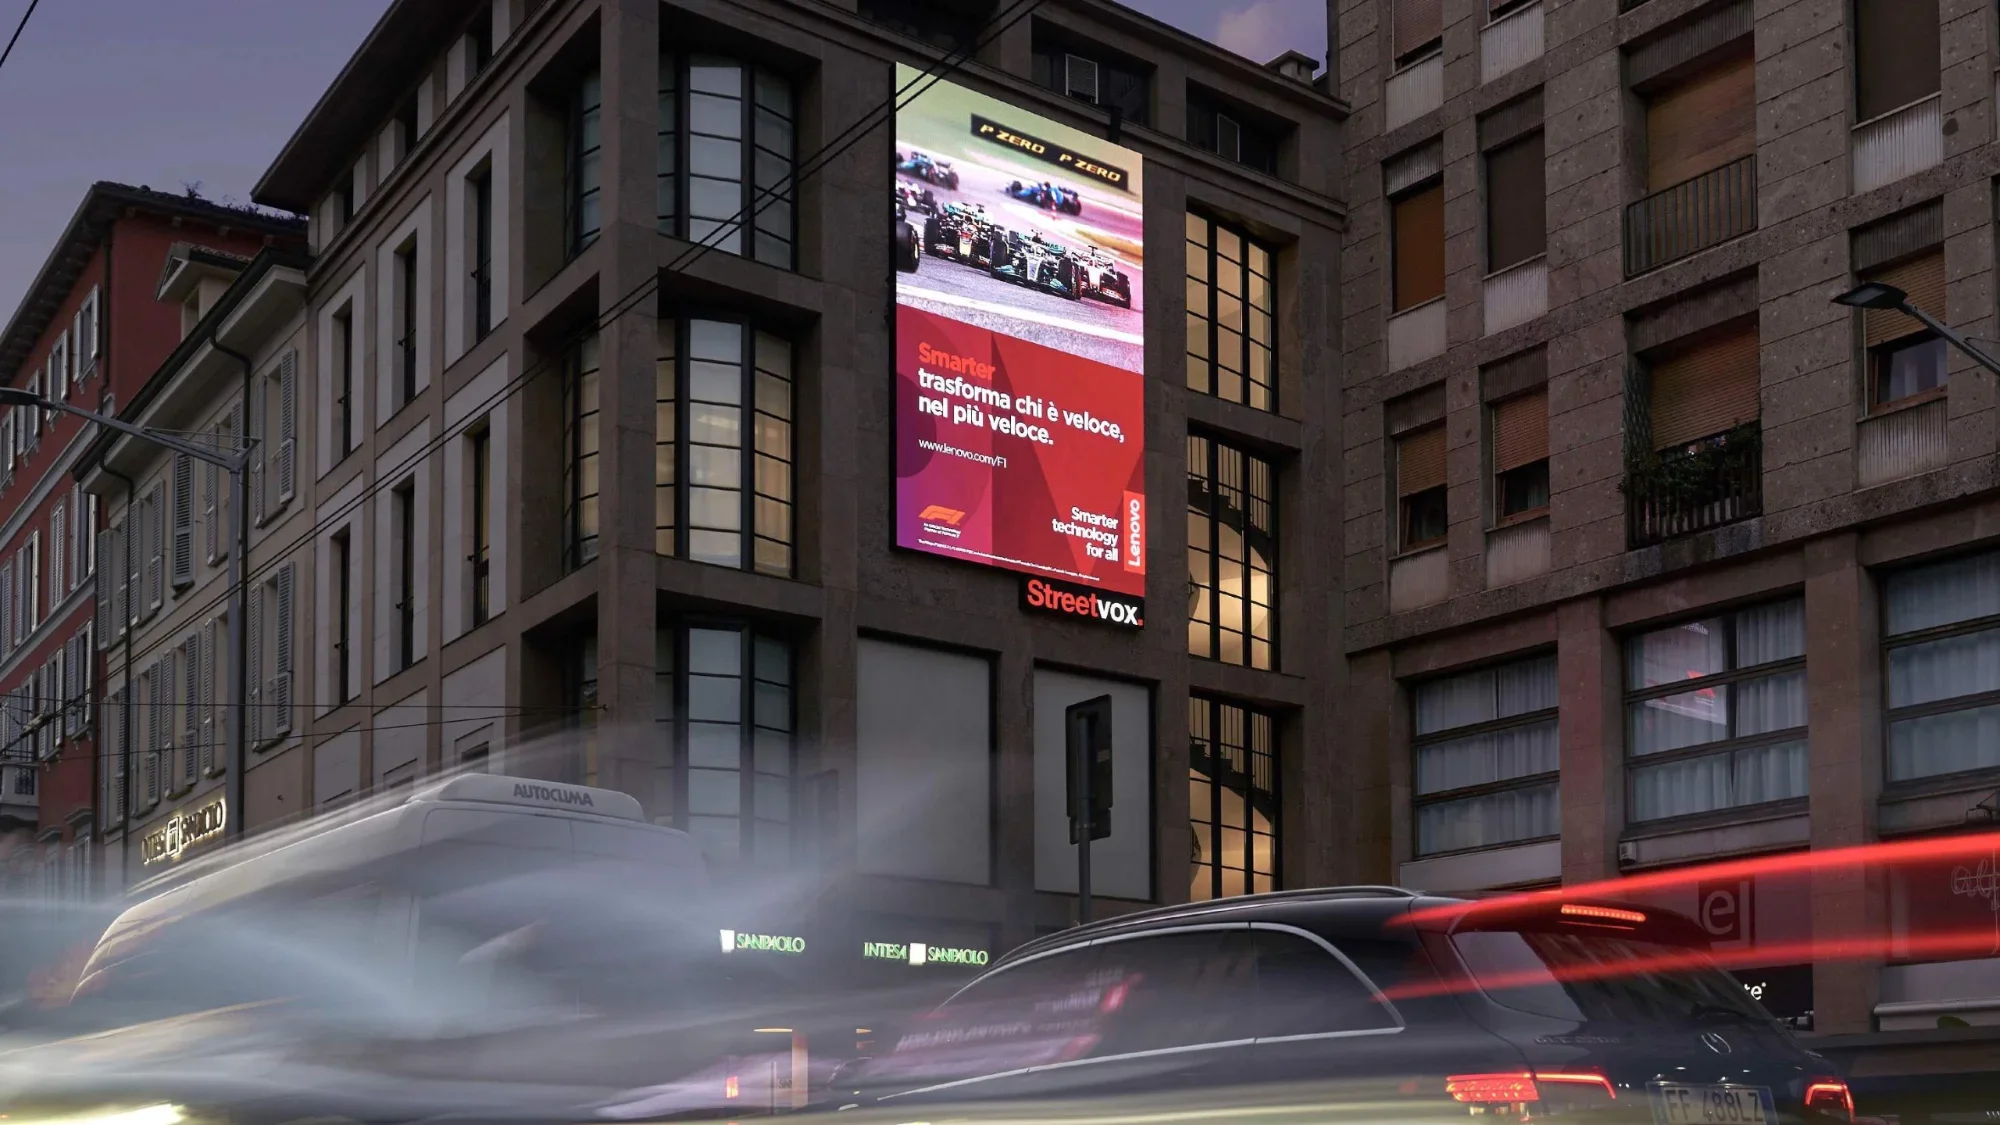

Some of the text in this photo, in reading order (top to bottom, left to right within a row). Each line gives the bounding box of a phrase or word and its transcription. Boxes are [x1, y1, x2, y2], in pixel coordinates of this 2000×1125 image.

[980, 124, 1121, 181] P ZERO P ZERO
[919, 342, 996, 381] Smarter
[918, 367, 1125, 443] trasforma chi è veloce,
[918, 395, 1054, 445] nel più veloce.
[918, 439, 1007, 469] www.lenovo.com/F1
[1052, 518, 1119, 548] technology
[1071, 506, 1119, 530] Smarter
[1128, 499, 1141, 567] Lenovo
[1086, 542, 1119, 562] for all
[1027, 579, 1144, 626] Streetvox.
[513, 783, 594, 807] AUTOCLIMA
[736, 933, 806, 953] SANPAOLO
[864, 942, 989, 965] INTESA SANPAOLO
[1665, 1089, 1690, 1121] FF
